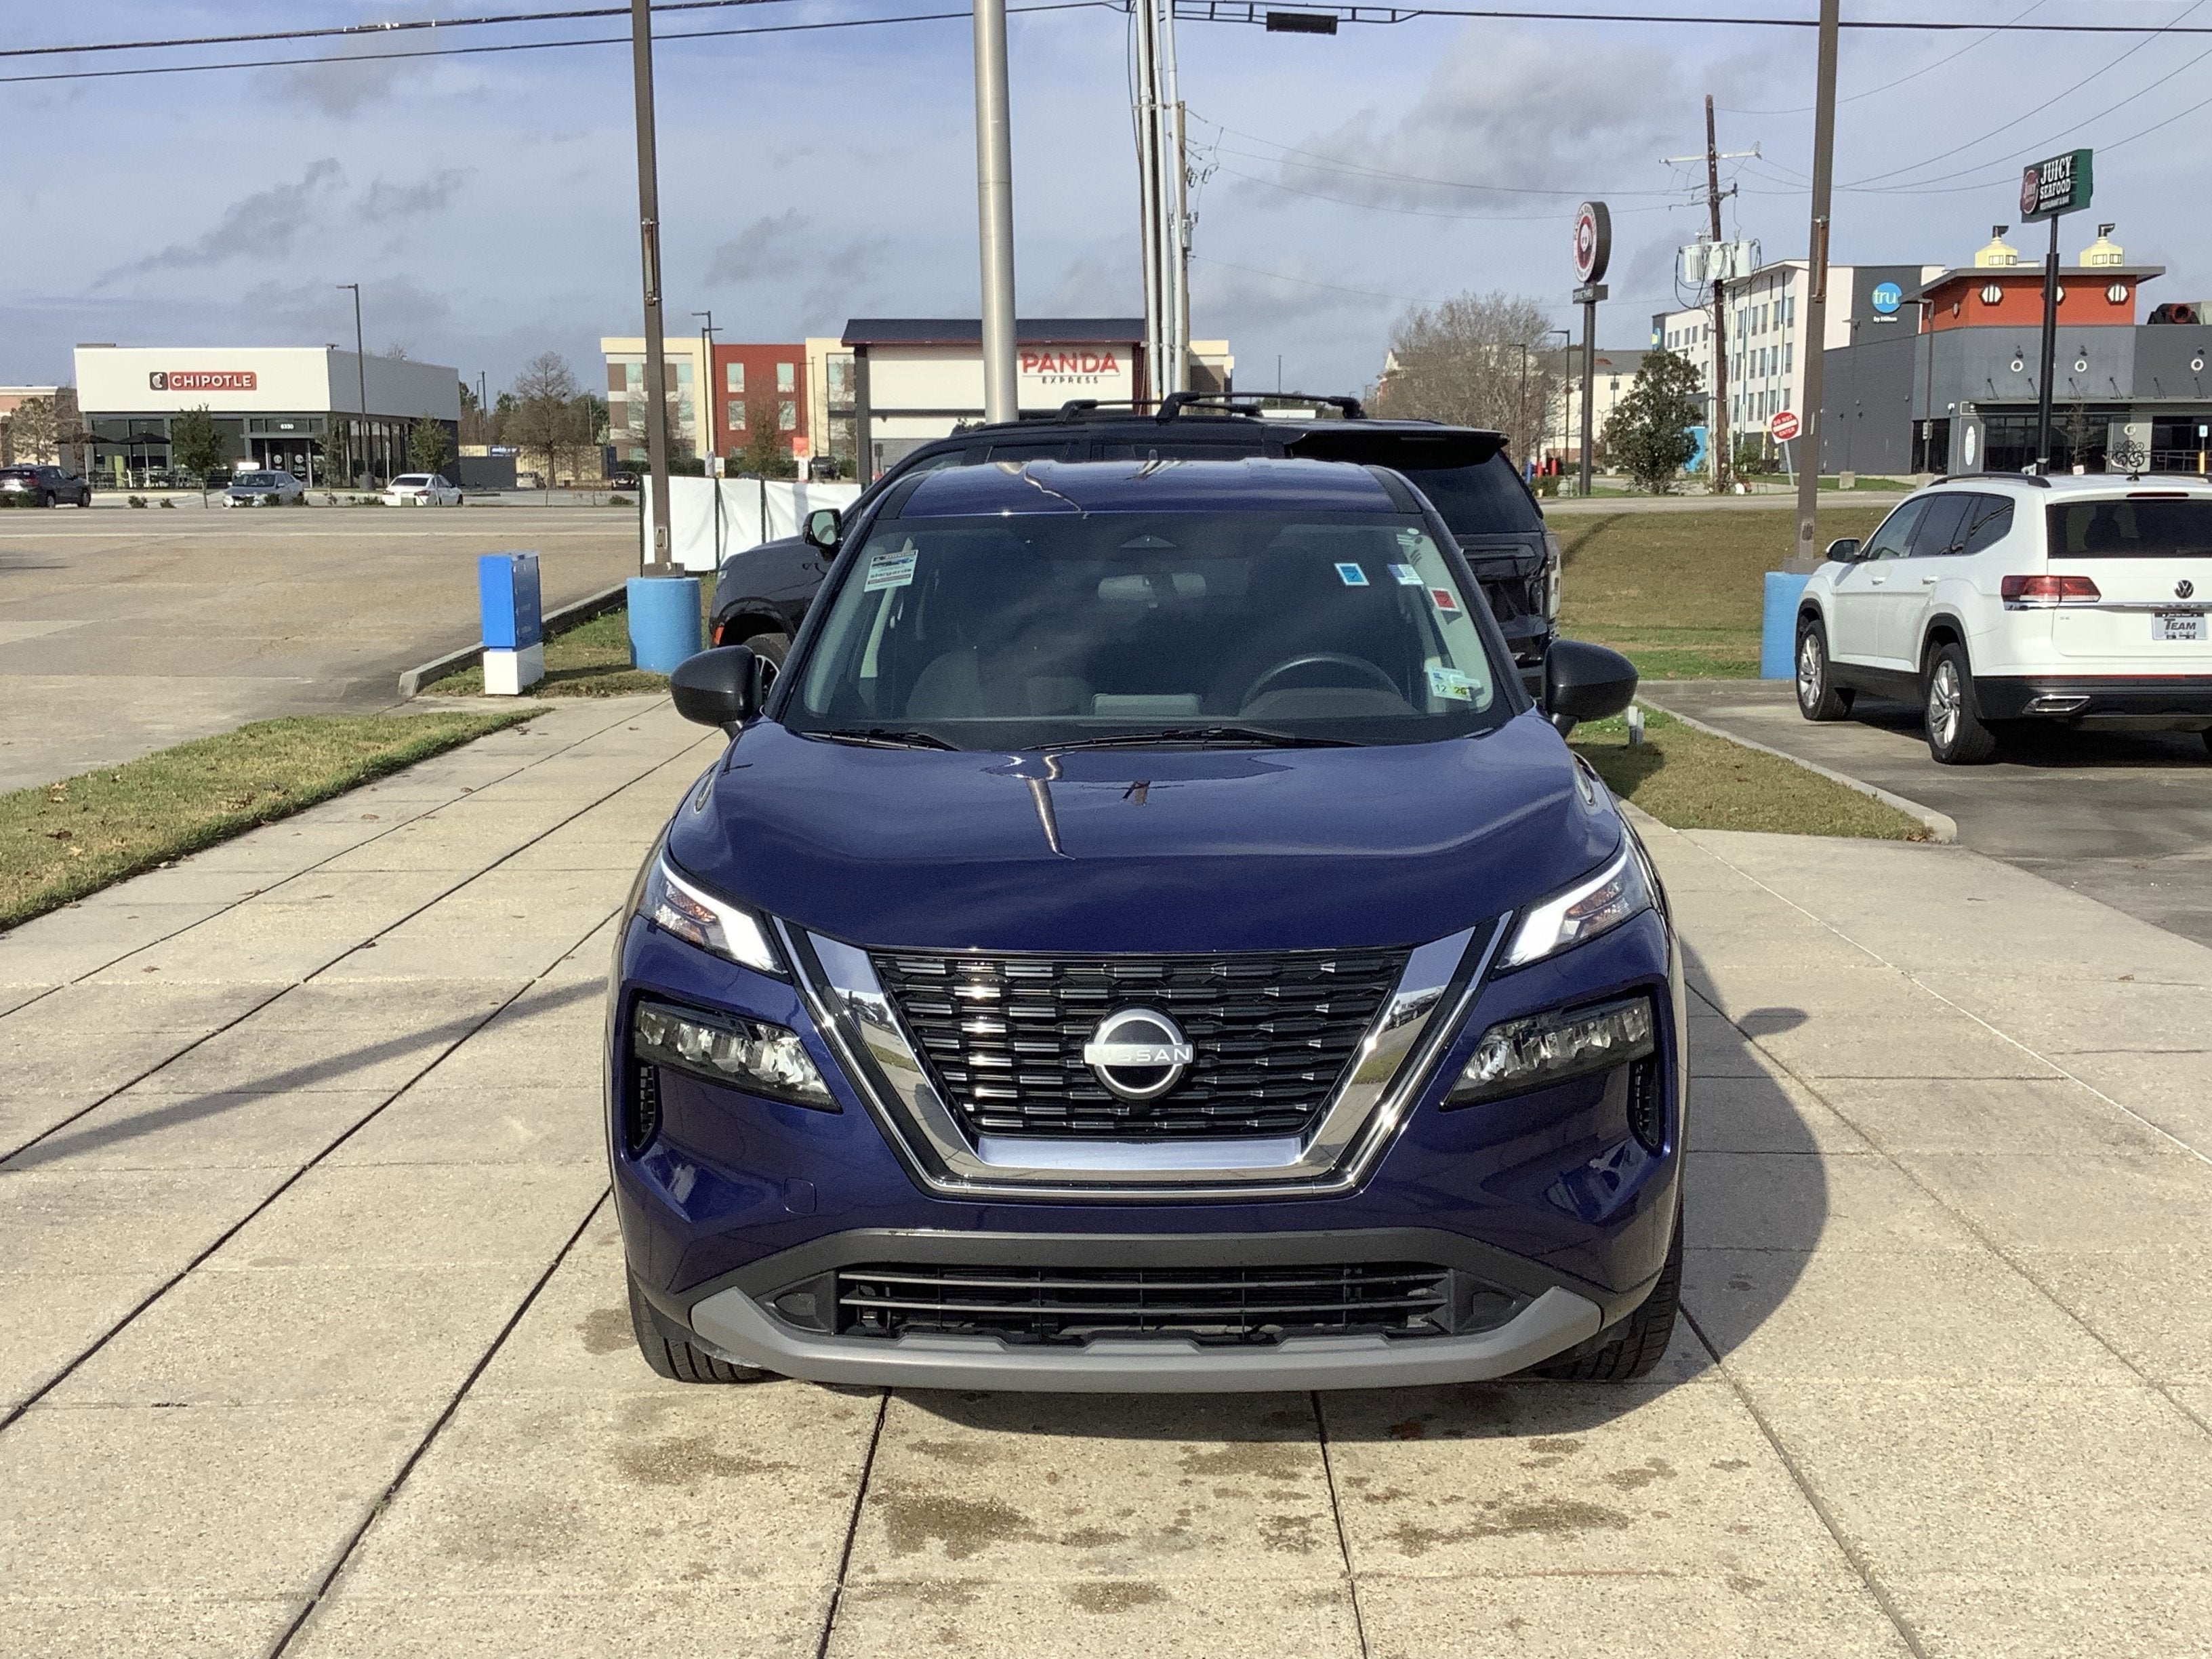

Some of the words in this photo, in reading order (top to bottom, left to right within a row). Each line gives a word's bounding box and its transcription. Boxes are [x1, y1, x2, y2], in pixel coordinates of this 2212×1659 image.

[2040, 155, 2072, 185] JUICY
[2039, 178, 2071, 200] SEAFOOD
[1873, 289, 1896, 304] tru
[1021, 352, 1119, 373] PANDA
[171, 375, 252, 388] CHIPOTLE
[1042, 376, 1099, 384] EXPRESS
[1778, 426, 1795, 436] ENTER
